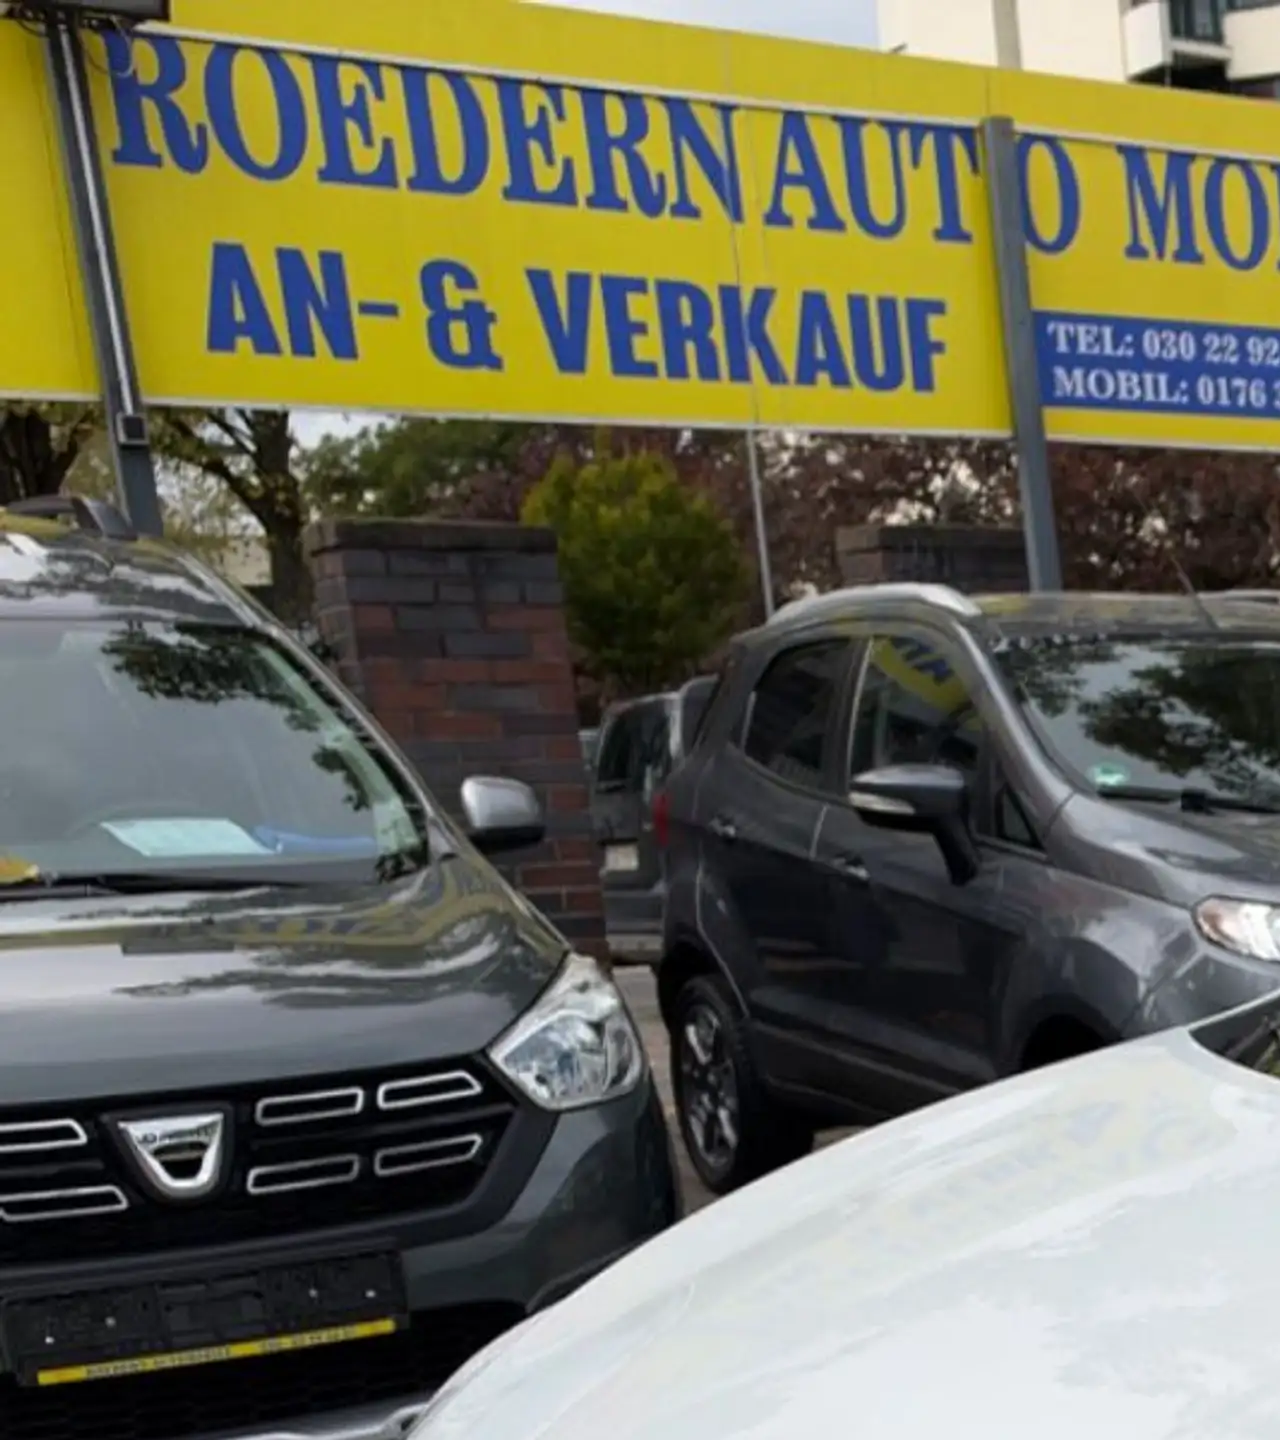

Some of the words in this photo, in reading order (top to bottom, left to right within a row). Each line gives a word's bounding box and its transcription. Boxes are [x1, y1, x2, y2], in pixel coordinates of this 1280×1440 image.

[103, 28, 744, 225] ROEDERN
[207, 242, 399, 361] AN-
[420, 259, 502, 371] &
[525, 268, 946, 393] VERKAUF
[1047, 321, 1134, 357] TEL:
[1142, 329, 1197, 360] 030
[1203, 332, 1239, 365] 22
[1247, 337, 1280, 367] 92
[1054, 366, 1188, 404] MOBIL:
[1198, 375, 1267, 408] 0176
